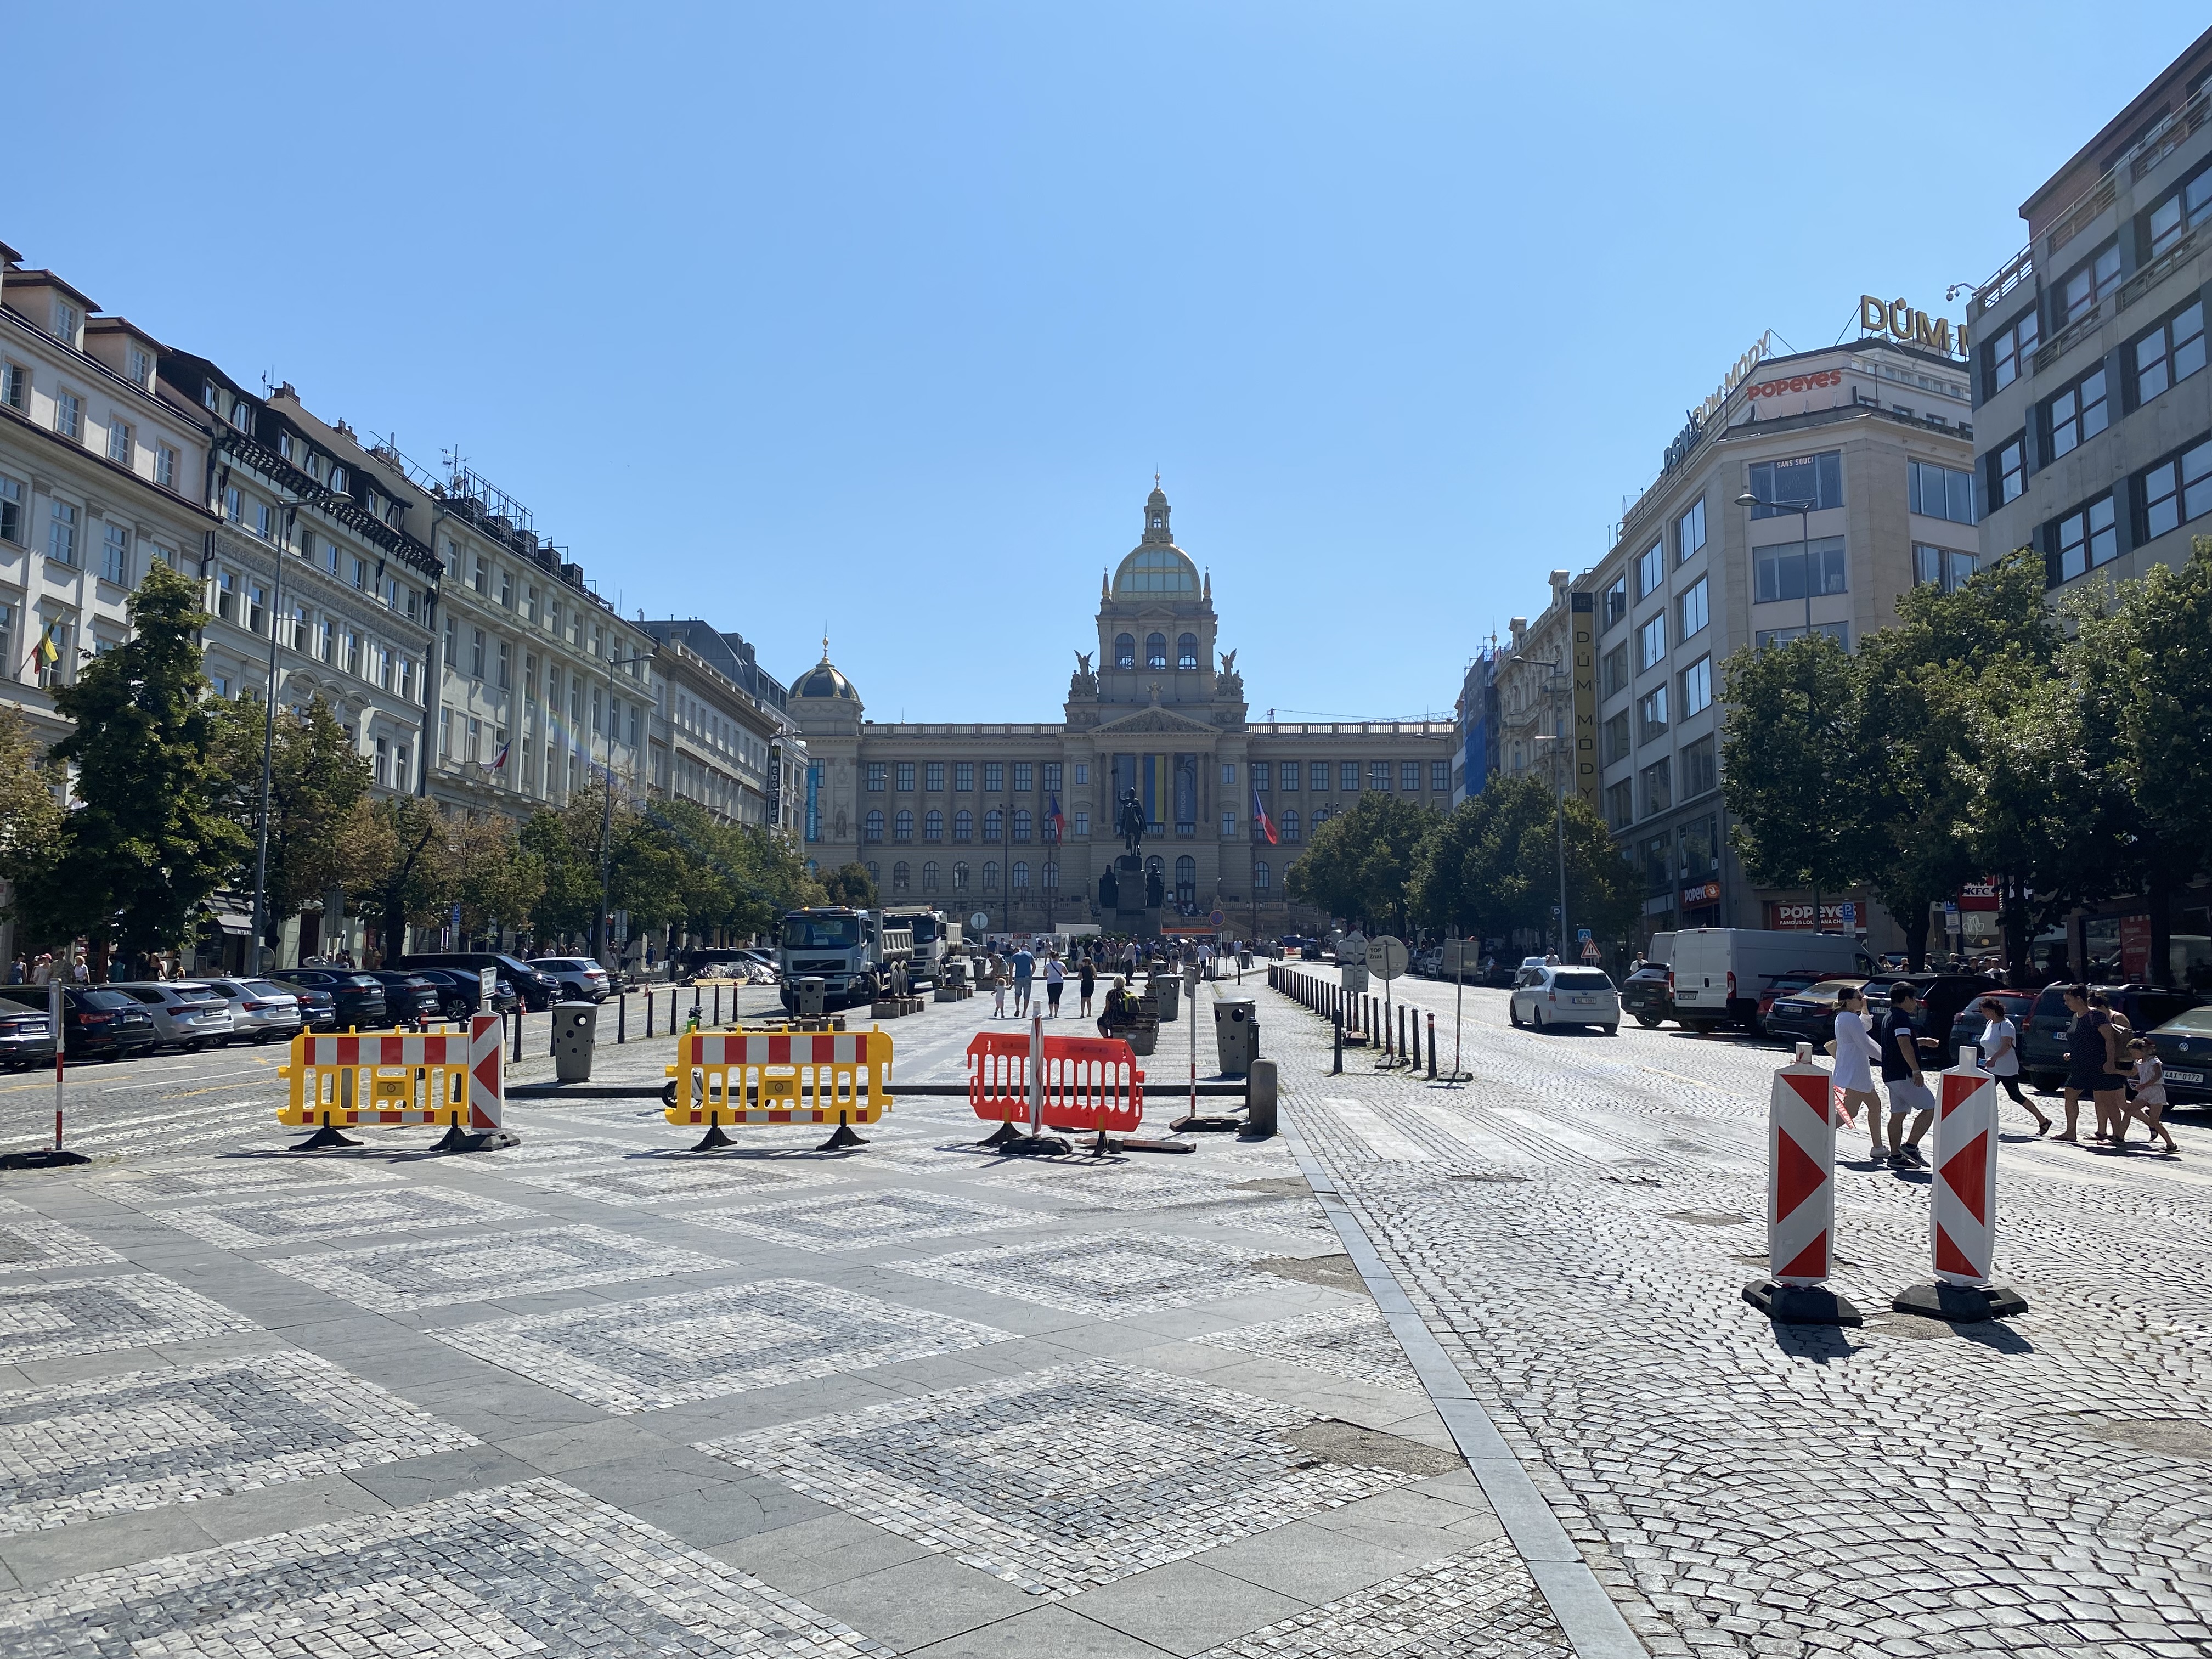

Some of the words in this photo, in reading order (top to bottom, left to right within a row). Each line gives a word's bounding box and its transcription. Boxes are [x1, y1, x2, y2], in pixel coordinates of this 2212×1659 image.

[1860, 295, 1950, 352] DŮM
[1777, 460, 1793, 469] SANS
[1795, 456, 1814, 466] SOUCI
[1576, 631, 1592, 691] DŮM
[1578, 715, 1594, 799] MÓDY
